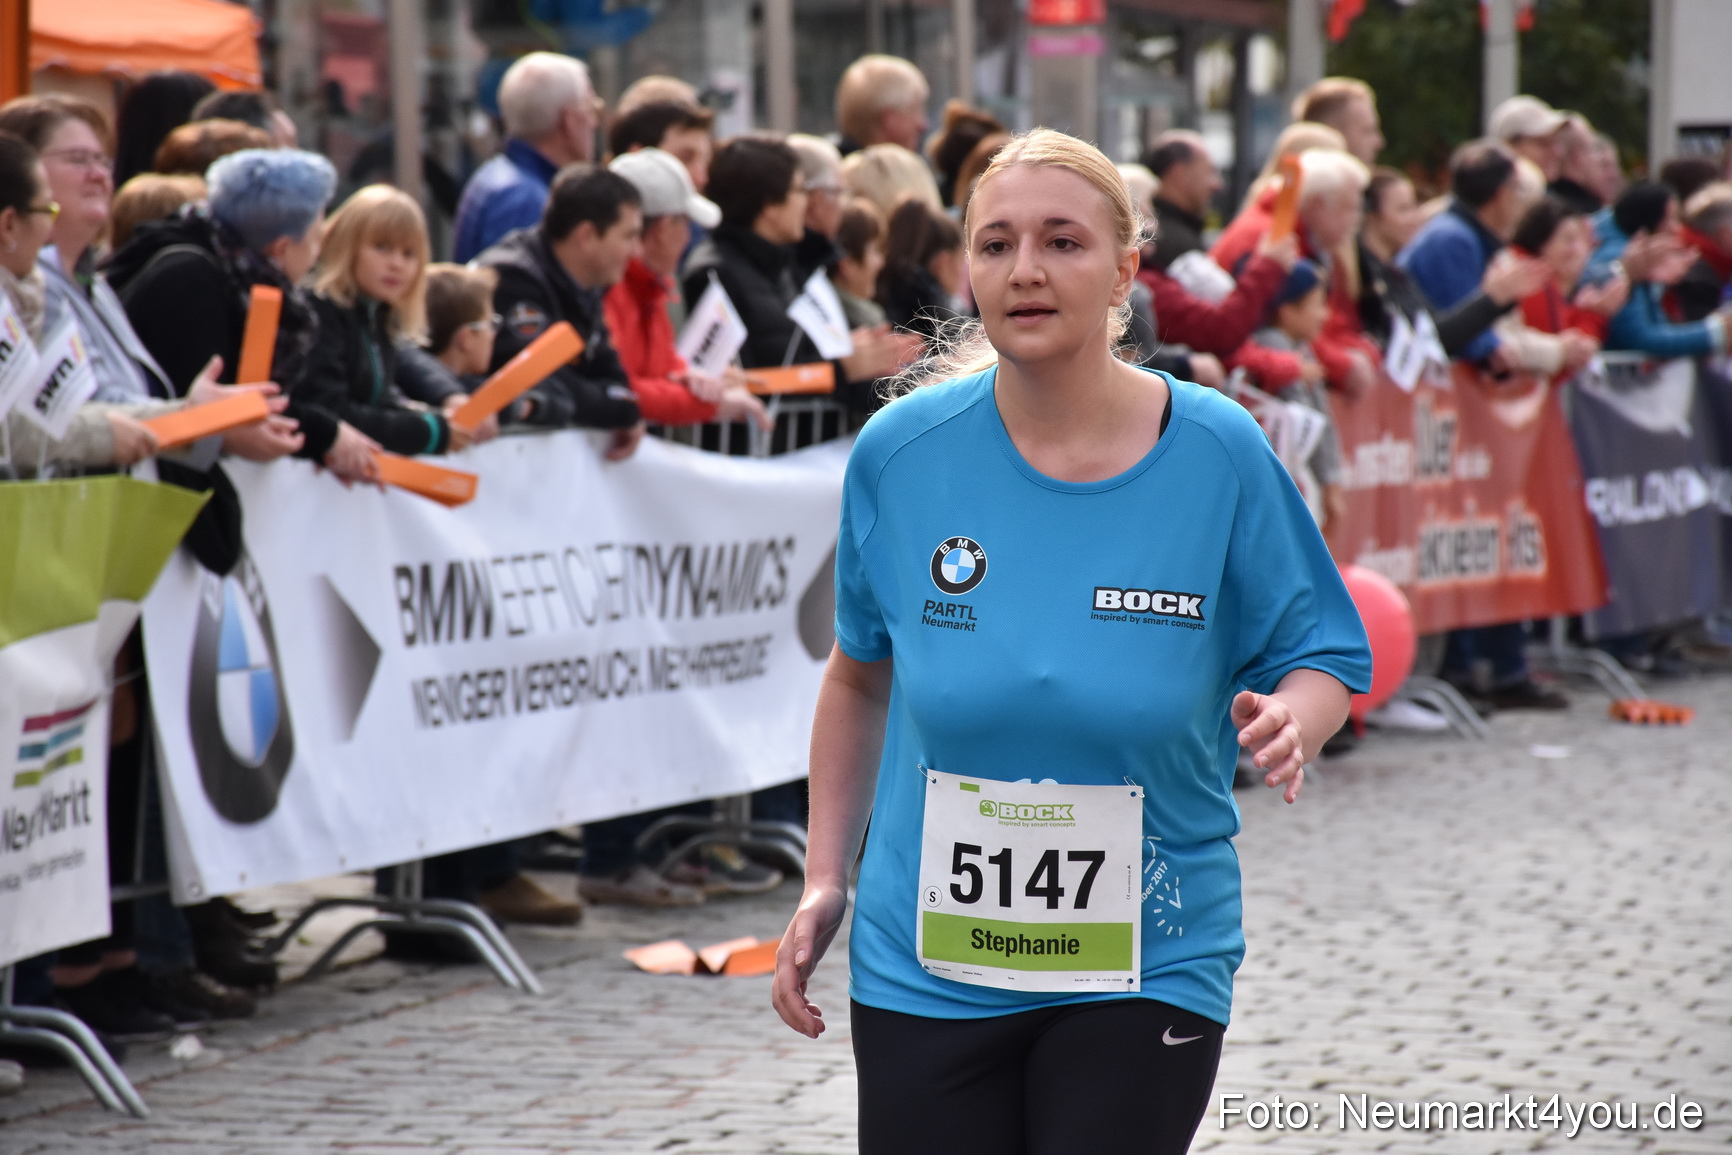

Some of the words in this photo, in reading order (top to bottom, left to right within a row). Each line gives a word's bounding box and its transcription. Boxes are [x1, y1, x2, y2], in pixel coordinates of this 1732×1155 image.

[940, 538, 985, 560] BMW
[394, 558, 494, 647] BMW
[923, 599, 978, 621] PARTL
[1092, 586, 1206, 620] BOCK
[921, 613, 977, 633] Neumarkt
[1090, 611, 1127, 623] inspired
[1129, 614, 1141, 625] by
[1143, 616, 1169, 626] smart
[1171, 619, 1206, 631] concepts
[998, 802, 1075, 821] BOCK
[998, 819, 1021, 827] inspired
[1049, 821, 1076, 829] concepts
[949, 841, 1106, 910] 5147
[1141, 882, 1155, 904] ber
[1150, 861, 1169, 886] 2017
[928, 891, 937, 903] S
[971, 928, 1081, 958] Stephanie
